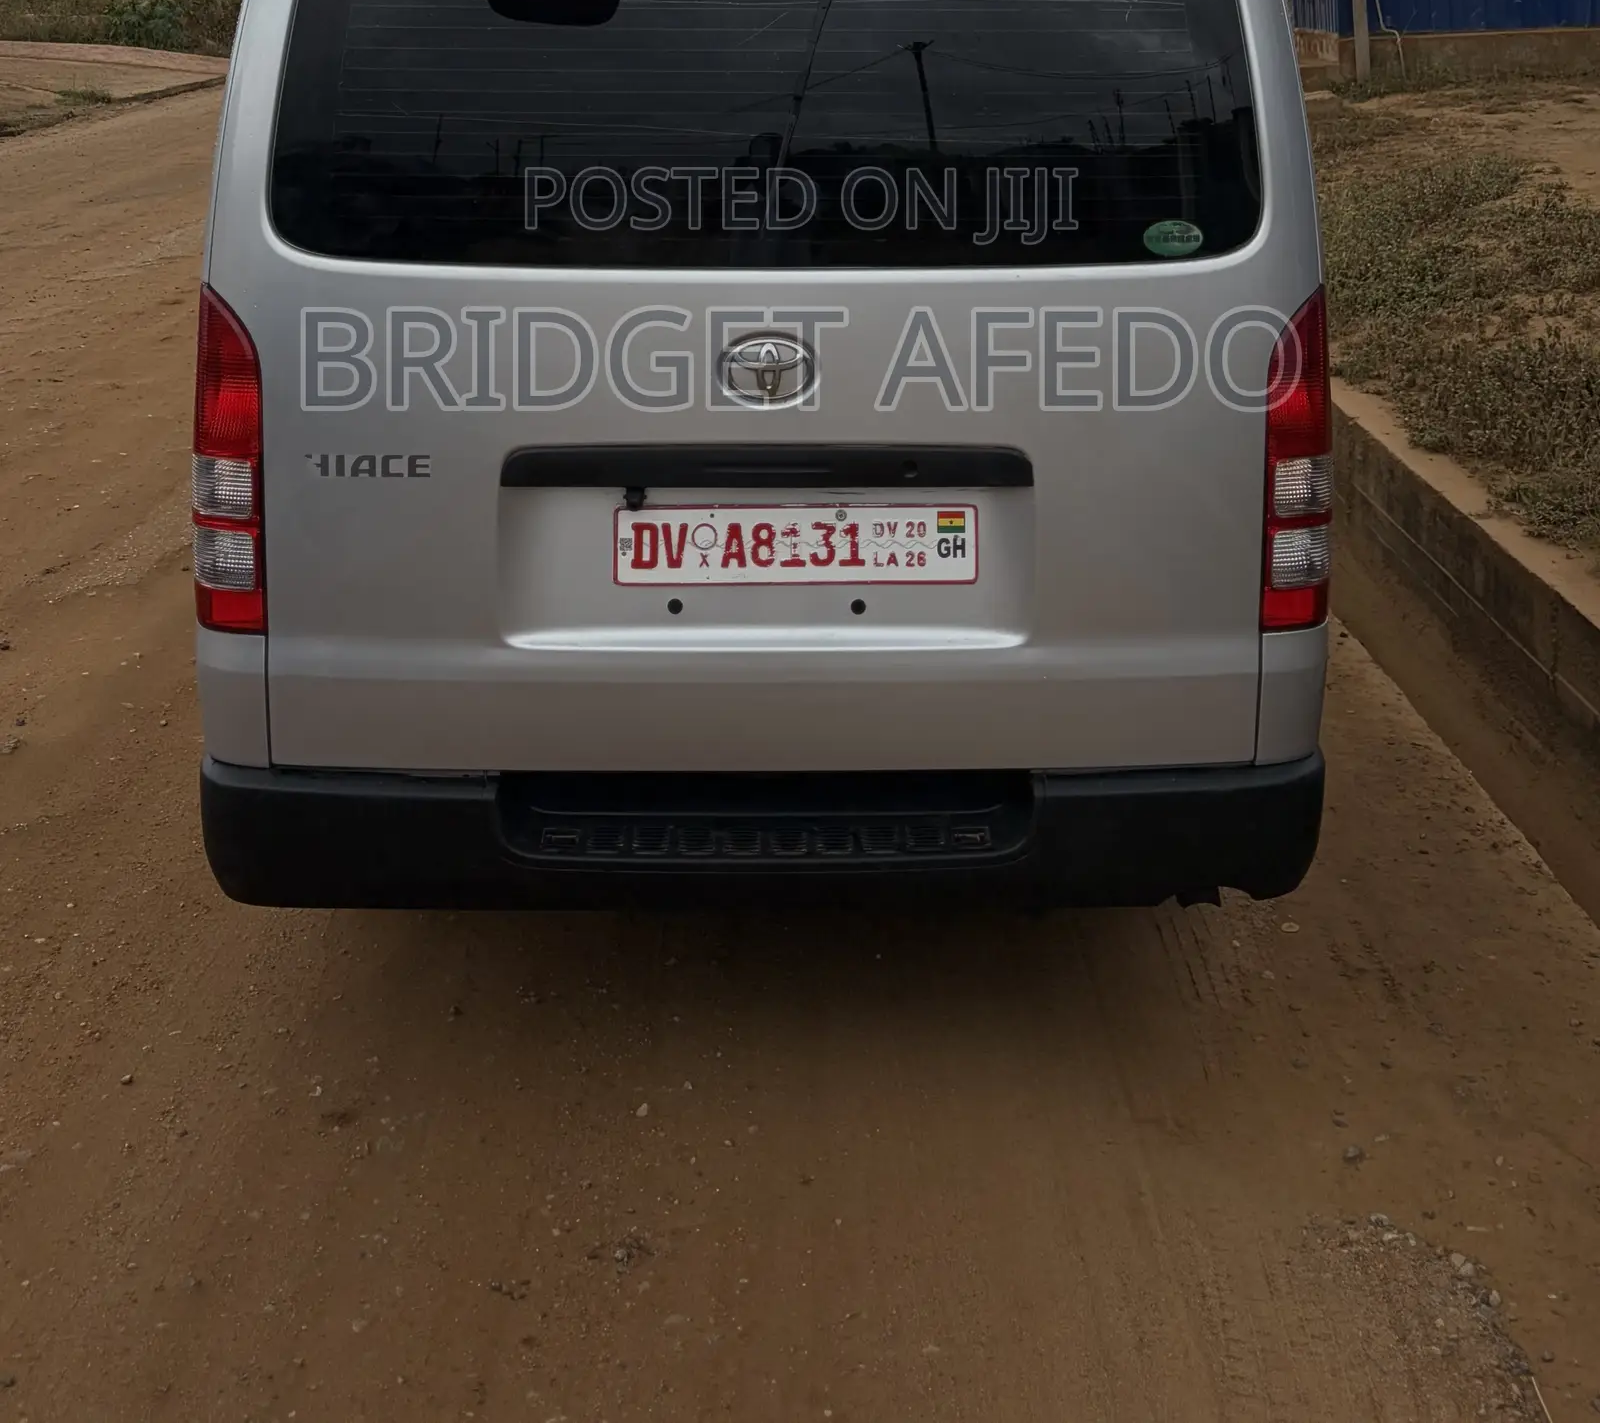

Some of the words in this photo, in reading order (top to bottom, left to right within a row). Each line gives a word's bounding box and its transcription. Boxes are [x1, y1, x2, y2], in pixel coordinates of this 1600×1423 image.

[631, 522, 689, 569] DV
[721, 522, 866, 569] A8131
[937, 537, 966, 559] GH
[873, 551, 899, 568] LA
